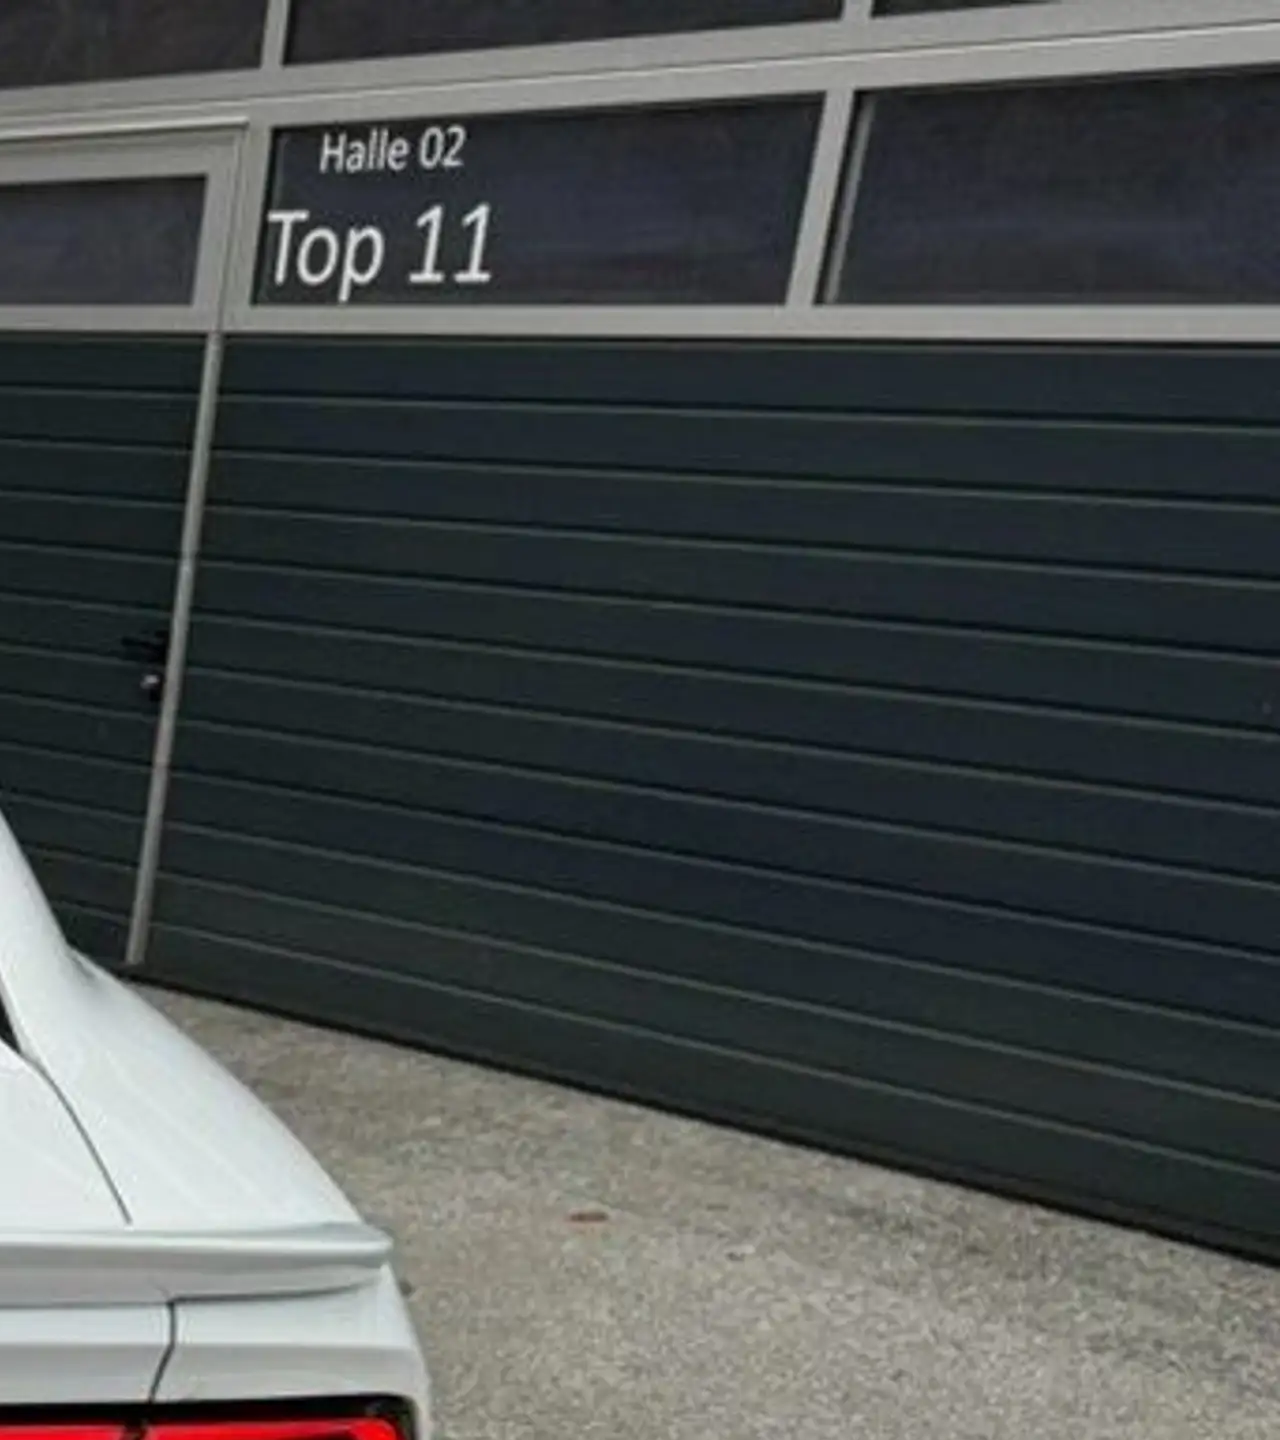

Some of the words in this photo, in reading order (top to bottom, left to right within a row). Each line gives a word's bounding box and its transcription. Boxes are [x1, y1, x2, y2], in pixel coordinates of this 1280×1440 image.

[319, 126, 410, 174] Halle
[420, 124, 466, 170] 02
[268, 209, 385, 302] Top
[409, 203, 491, 284] 11
